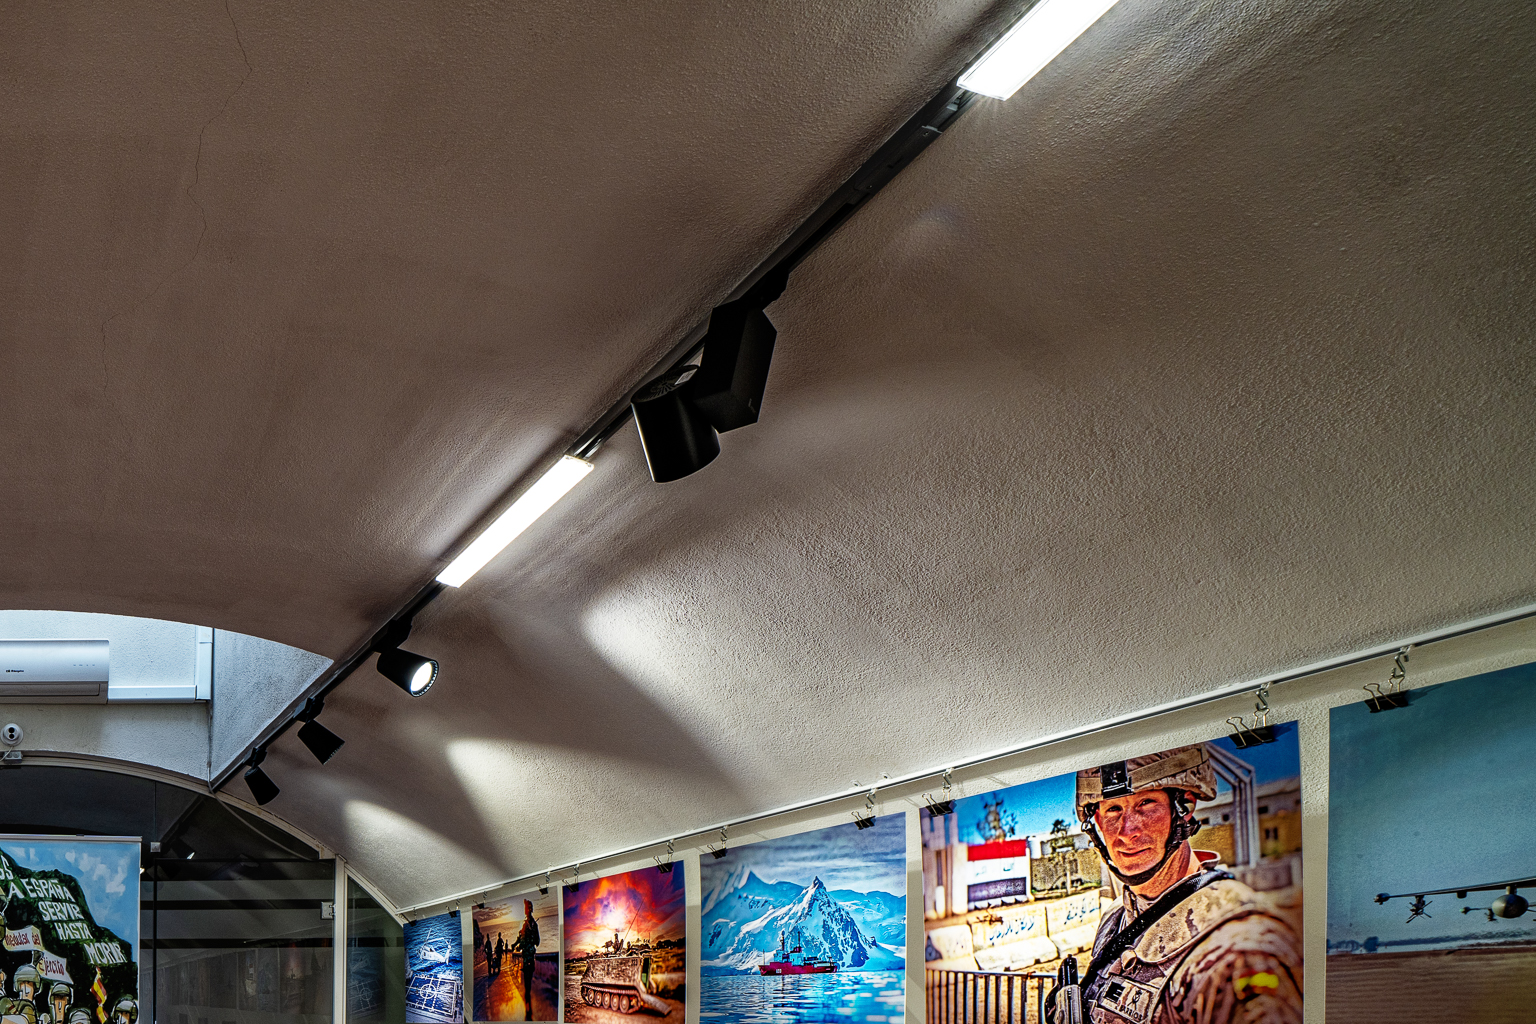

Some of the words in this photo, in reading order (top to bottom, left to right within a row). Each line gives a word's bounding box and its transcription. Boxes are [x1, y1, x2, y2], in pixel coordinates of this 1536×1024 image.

[8, 881, 25, 899] A
[20, 878, 75, 902] ESPAÑA
[38, 900, 84, 921] SERVIR
[54, 922, 94, 940] HASTA
[83, 941, 128, 964] MORIR
